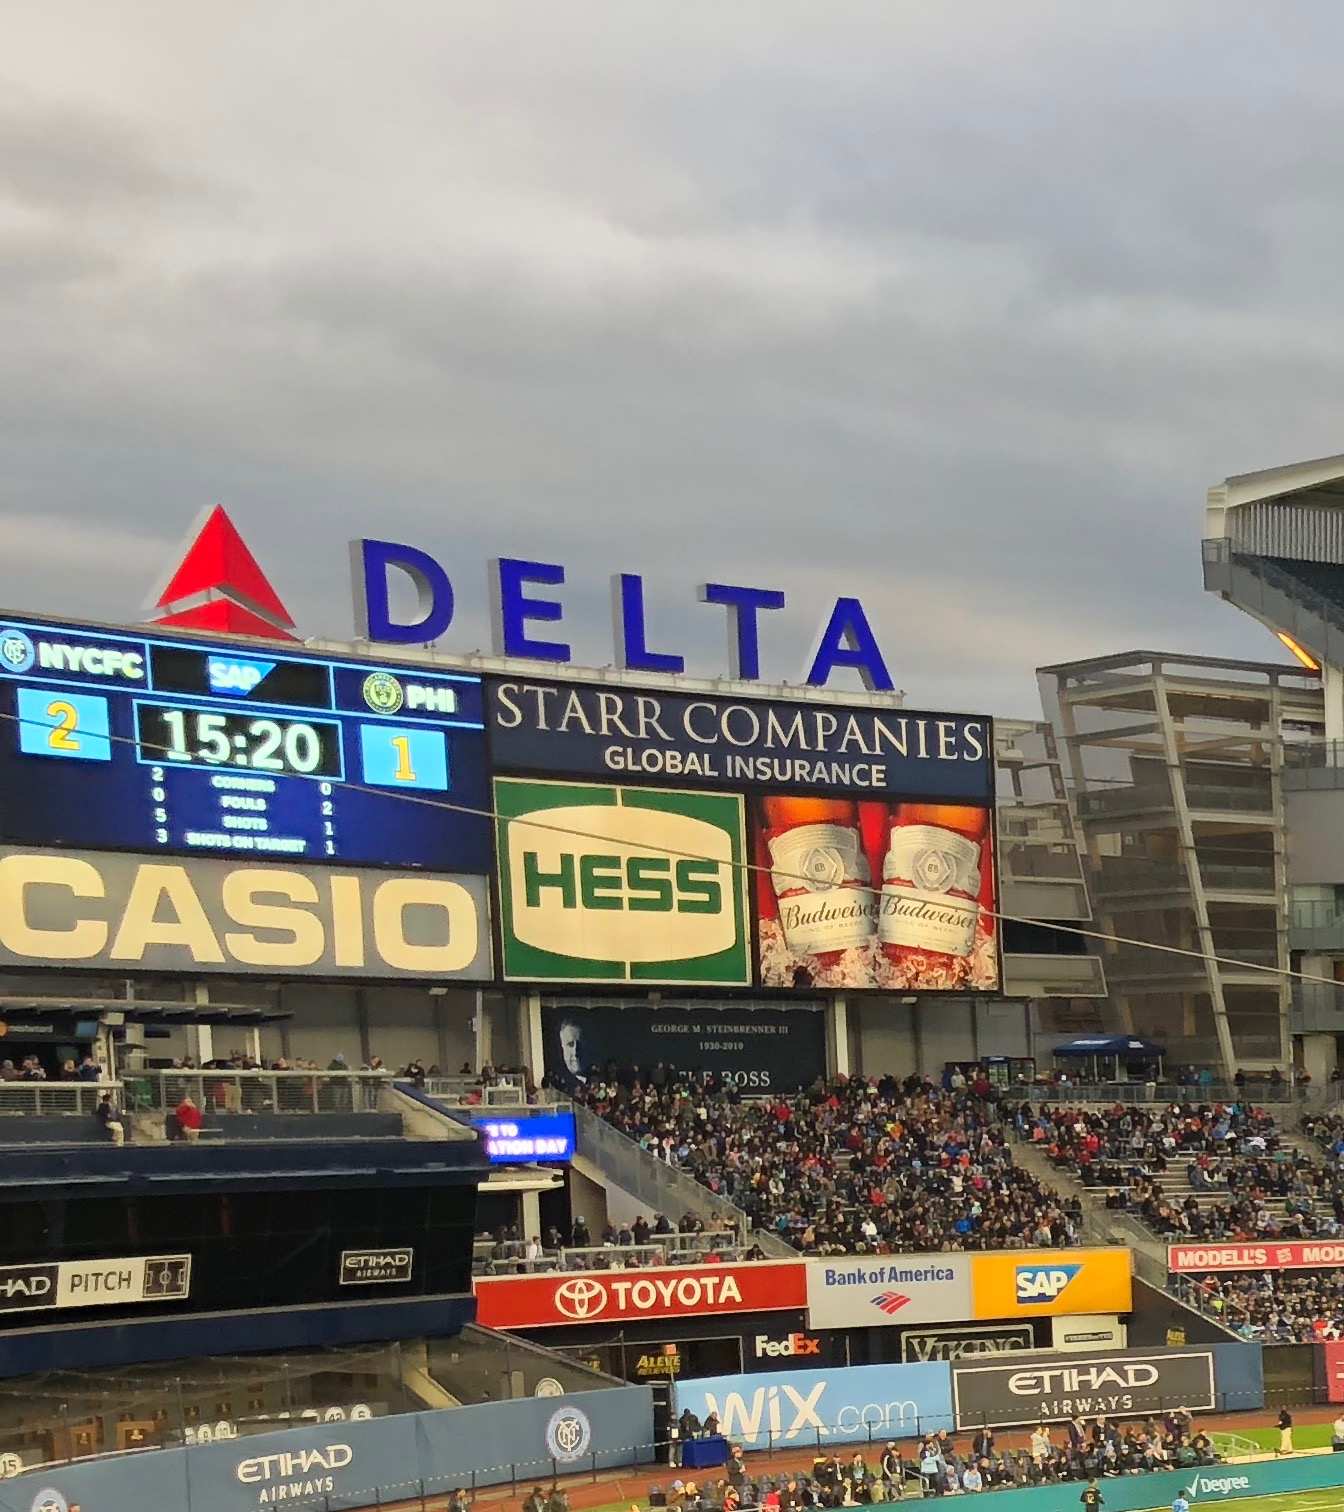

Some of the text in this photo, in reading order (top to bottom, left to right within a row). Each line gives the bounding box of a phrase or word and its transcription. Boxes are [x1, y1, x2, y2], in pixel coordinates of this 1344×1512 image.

[350, 538, 896, 692] DELTA
[38, 641, 145, 679] NYCFC
[208, 662, 262, 692] SAP
[406, 685, 457, 714] PHI
[46, 700, 80, 751] 2
[496, 683, 983, 762] STARR COMPANIES
[163, 711, 321, 774] 15:20
[392, 736, 417, 781] 1
[604, 745, 887, 787] GLOBAL INSURANCE
[152, 767, 164, 782] 2
[152, 787, 333, 816] 0 FOULS 2
[154, 808, 334, 836] 5 SHOTS 1
[156, 828, 168, 843] 3
[325, 840, 335, 855] 1
[523, 851, 722, 915] HESS
[0, 855, 478, 972] CASIO
[783, 899, 875, 930] Budweiser
[882, 895, 975, 929] Budweiser
[651, 1025, 690, 1034] GEORGE
[706, 1025, 776, 1034] STEINBRENNER
[535, 1138, 568, 1155] DAY
[346, 1253, 409, 1269] ETIHAD
[1177, 1248, 1268, 1267] MODELL'S
[70, 1270, 132, 1294] PITCH
[825, 1265, 954, 1286] Bank of America
[1016, 1271, 1070, 1298] SAP
[611, 1275, 743, 1311] TOYOTA
[754, 1332, 821, 1358] FedEx
[1008, 1363, 1159, 1396] ETIHAD
[1041, 1395, 1134, 1416] AIRWAYS
[237, 1444, 354, 1484] ETIHAD
[259, 1476, 335, 1505] AIRWAYS
[1200, 1475, 1250, 1496] Degree
